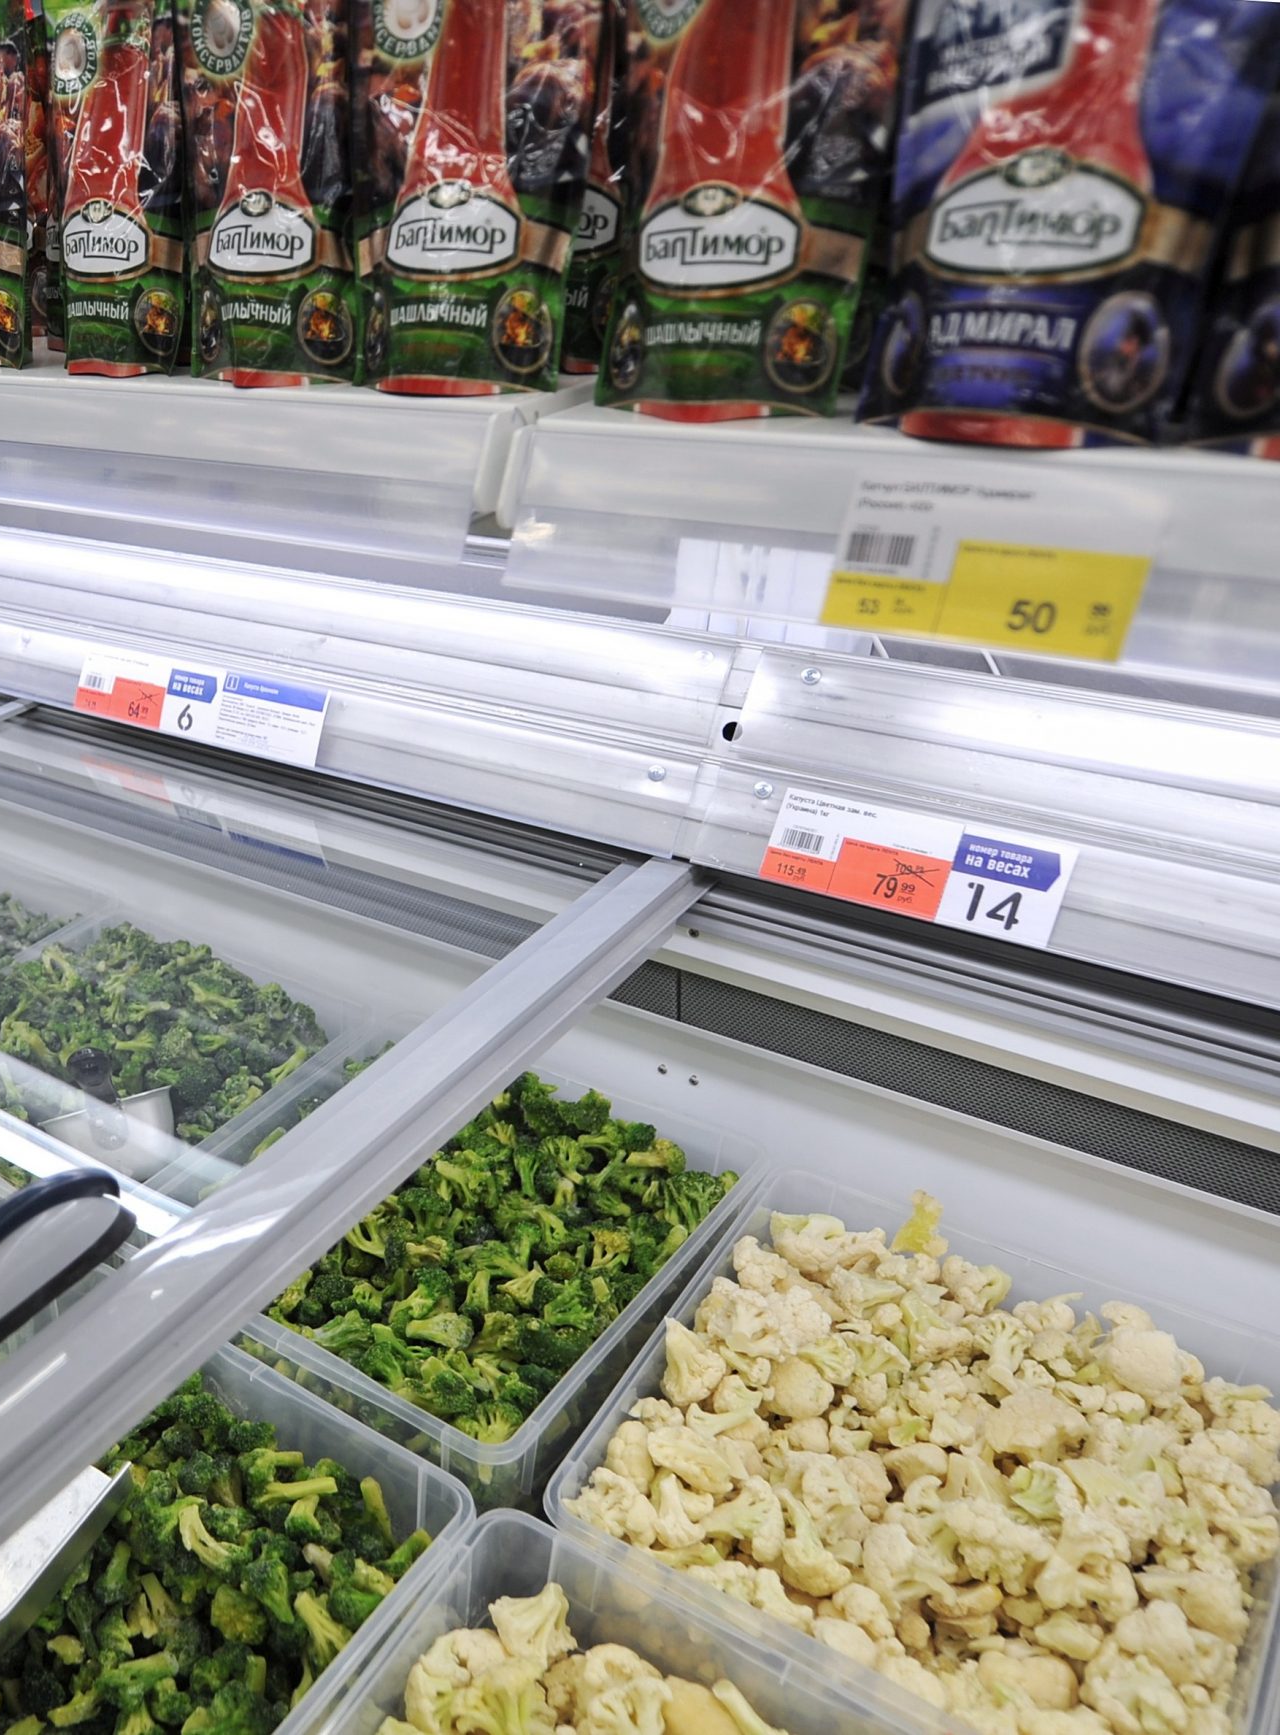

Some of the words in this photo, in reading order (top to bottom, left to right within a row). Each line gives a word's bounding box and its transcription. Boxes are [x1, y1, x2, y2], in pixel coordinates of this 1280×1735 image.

[1006, 598, 1058, 634] 50
[128, 701, 141, 719] 64
[177, 703, 194, 732] 6
[964, 853, 984, 868] на
[986, 858, 1032, 879] весах
[968, 843, 999, 858] номер
[1000, 849, 1034, 865] товара
[873, 873, 898, 899] 79
[965, 881, 1023, 931] 14
